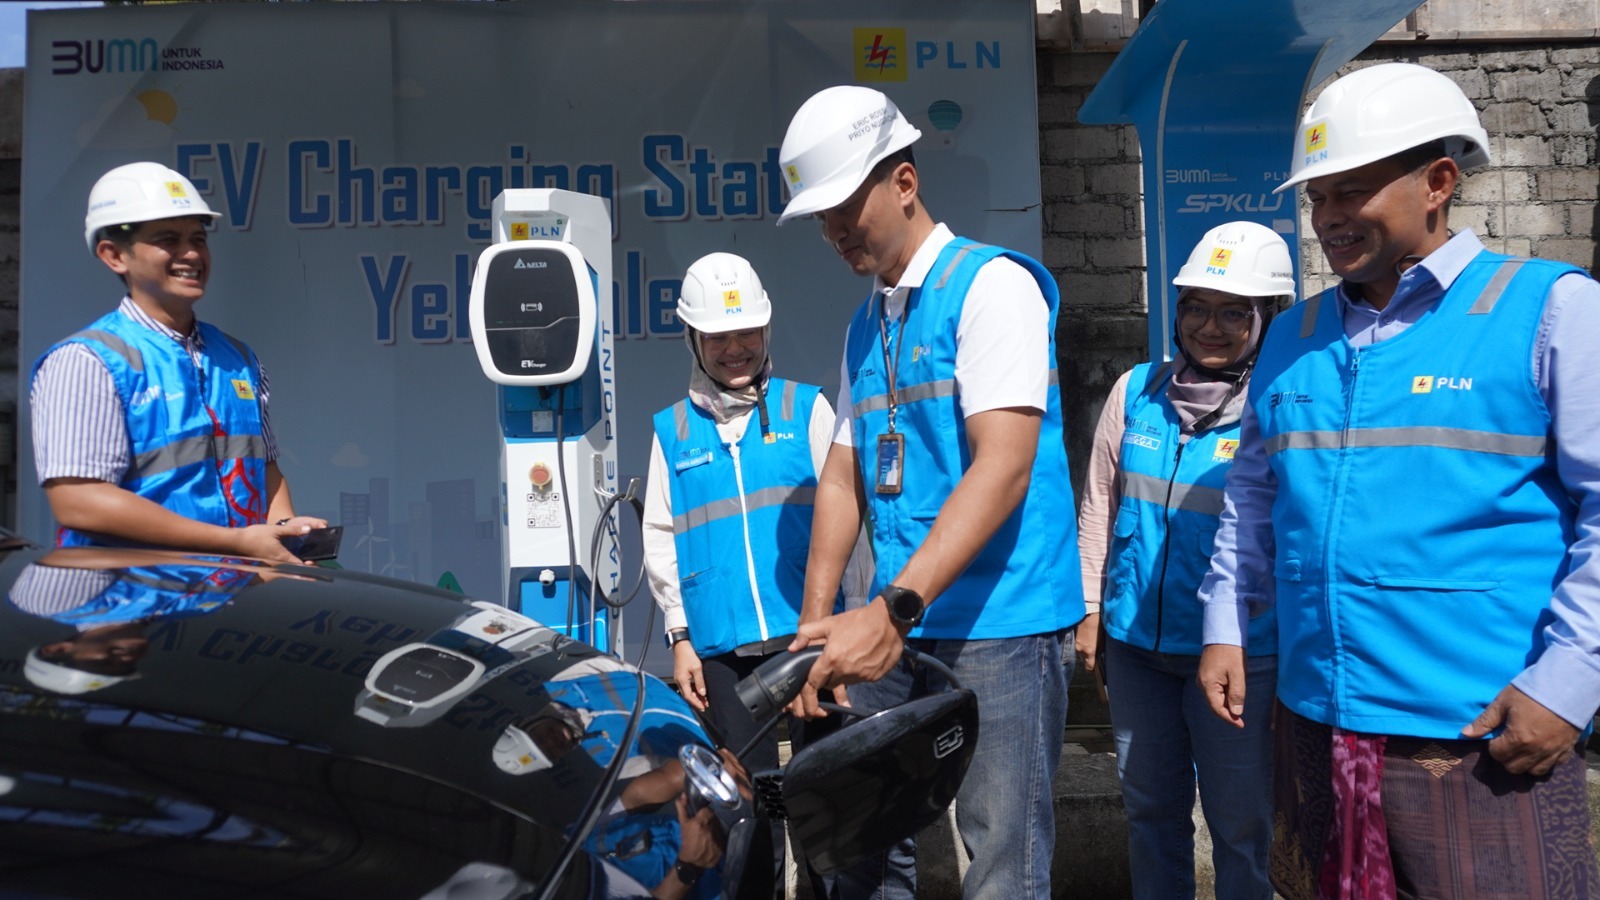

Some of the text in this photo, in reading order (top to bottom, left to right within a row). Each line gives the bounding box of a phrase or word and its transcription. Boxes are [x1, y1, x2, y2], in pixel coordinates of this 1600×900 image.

[52, 38, 158, 75] BUMN
[162, 48, 202, 58] UNTUK
[916, 41, 1001, 69] PLN
[162, 60, 225, 71] INDONESIA
[852, 116, 870, 130] ERIC
[848, 125, 871, 141] PRIYO
[1305, 150, 1328, 166] PLN
[643, 134, 783, 217] Stat
[1166, 169, 1210, 184] BUMN
[1264, 171, 1291, 181] PLN
[1176, 193, 1284, 213] SPKLU
[531, 226, 560, 236] PLN
[1206, 266, 1226, 276] PLN
[725, 306, 742, 315] PLN
[602, 320, 613, 440] POINT
[1436, 376, 1473, 391] PLN
[777, 432, 794, 440] PLN
